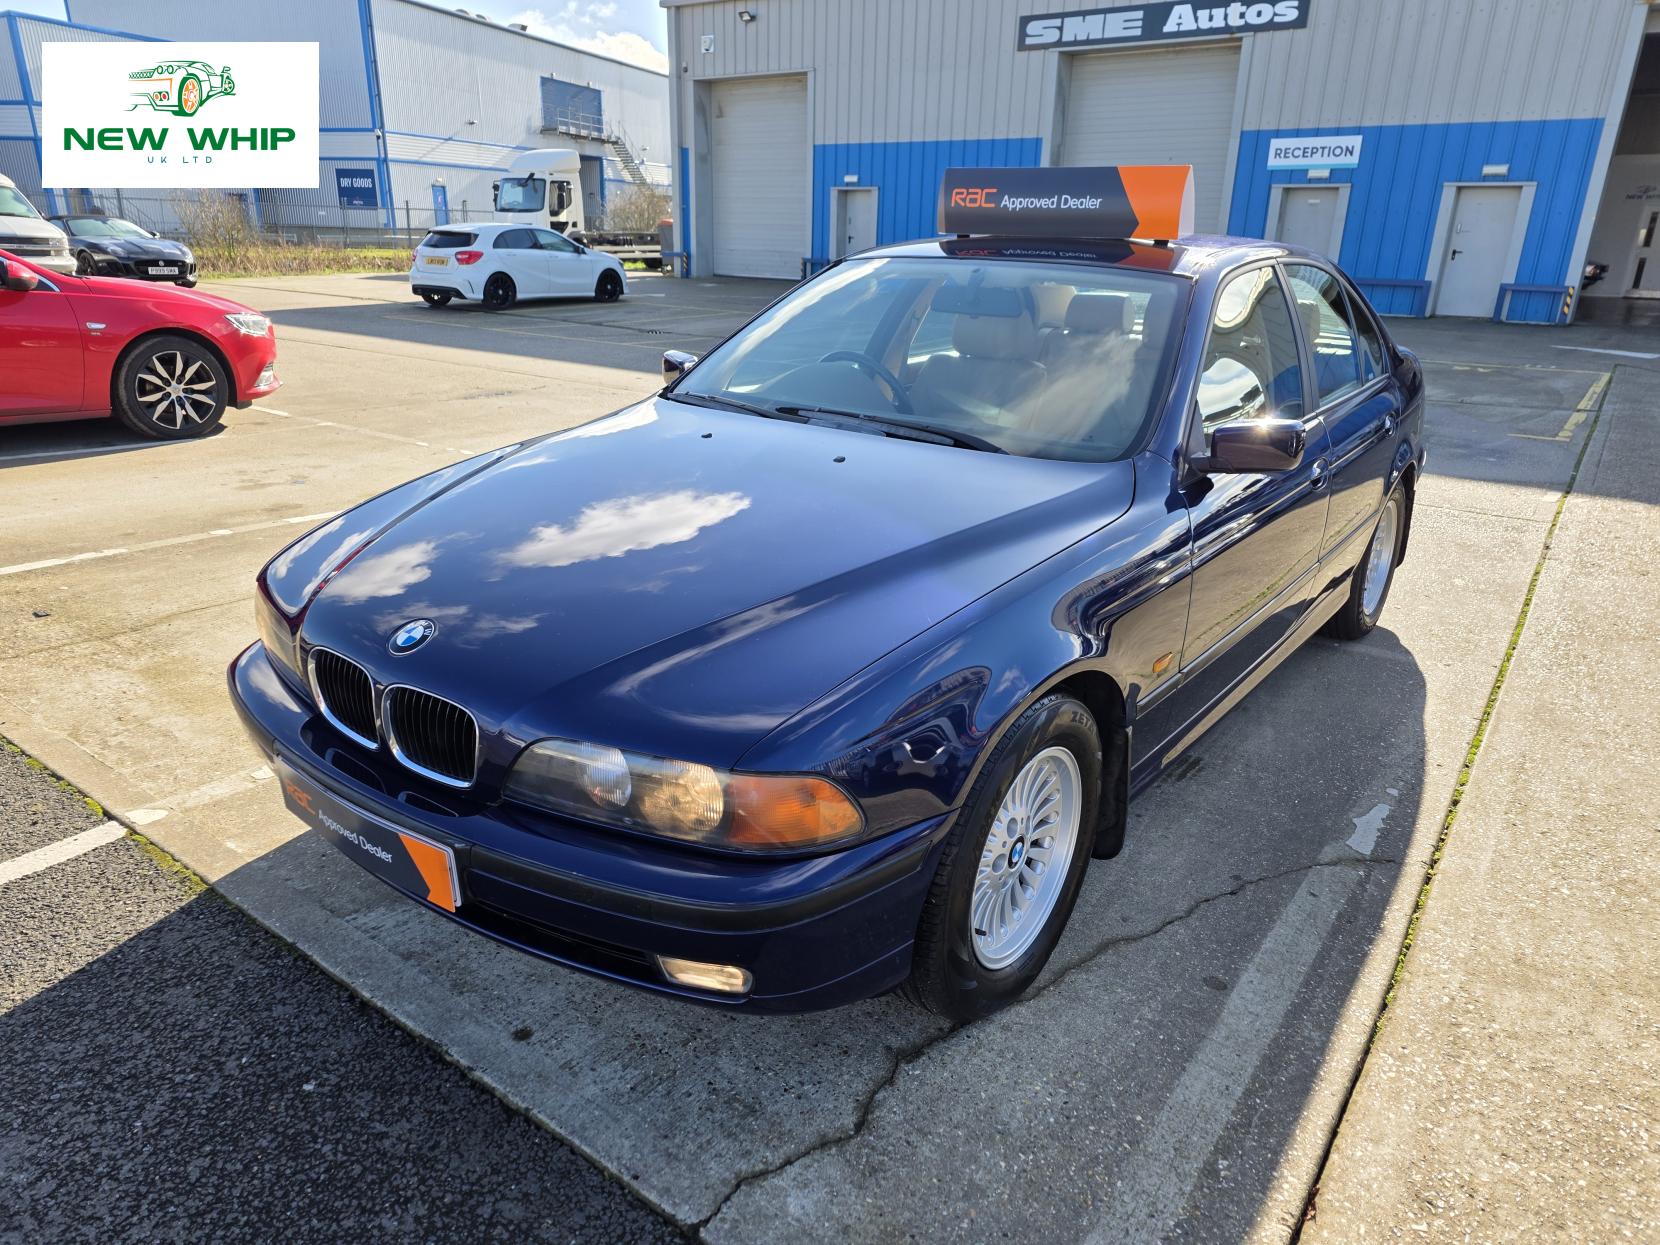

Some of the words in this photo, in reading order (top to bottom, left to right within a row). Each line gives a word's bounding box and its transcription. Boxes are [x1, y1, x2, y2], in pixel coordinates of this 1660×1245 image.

[1025, 10, 1144, 45] SME
[1162, 0, 1299, 33] Autos
[1274, 145, 1355, 159] RECEPTION
[340, 177, 352, 188] DRY
[352, 177, 373, 188] GOODS
[1000, 194, 1057, 212] Approved
[1060, 194, 1103, 210] Dealer
[318, 808, 357, 844] Approved
[359, 835, 393, 864] Dealer
